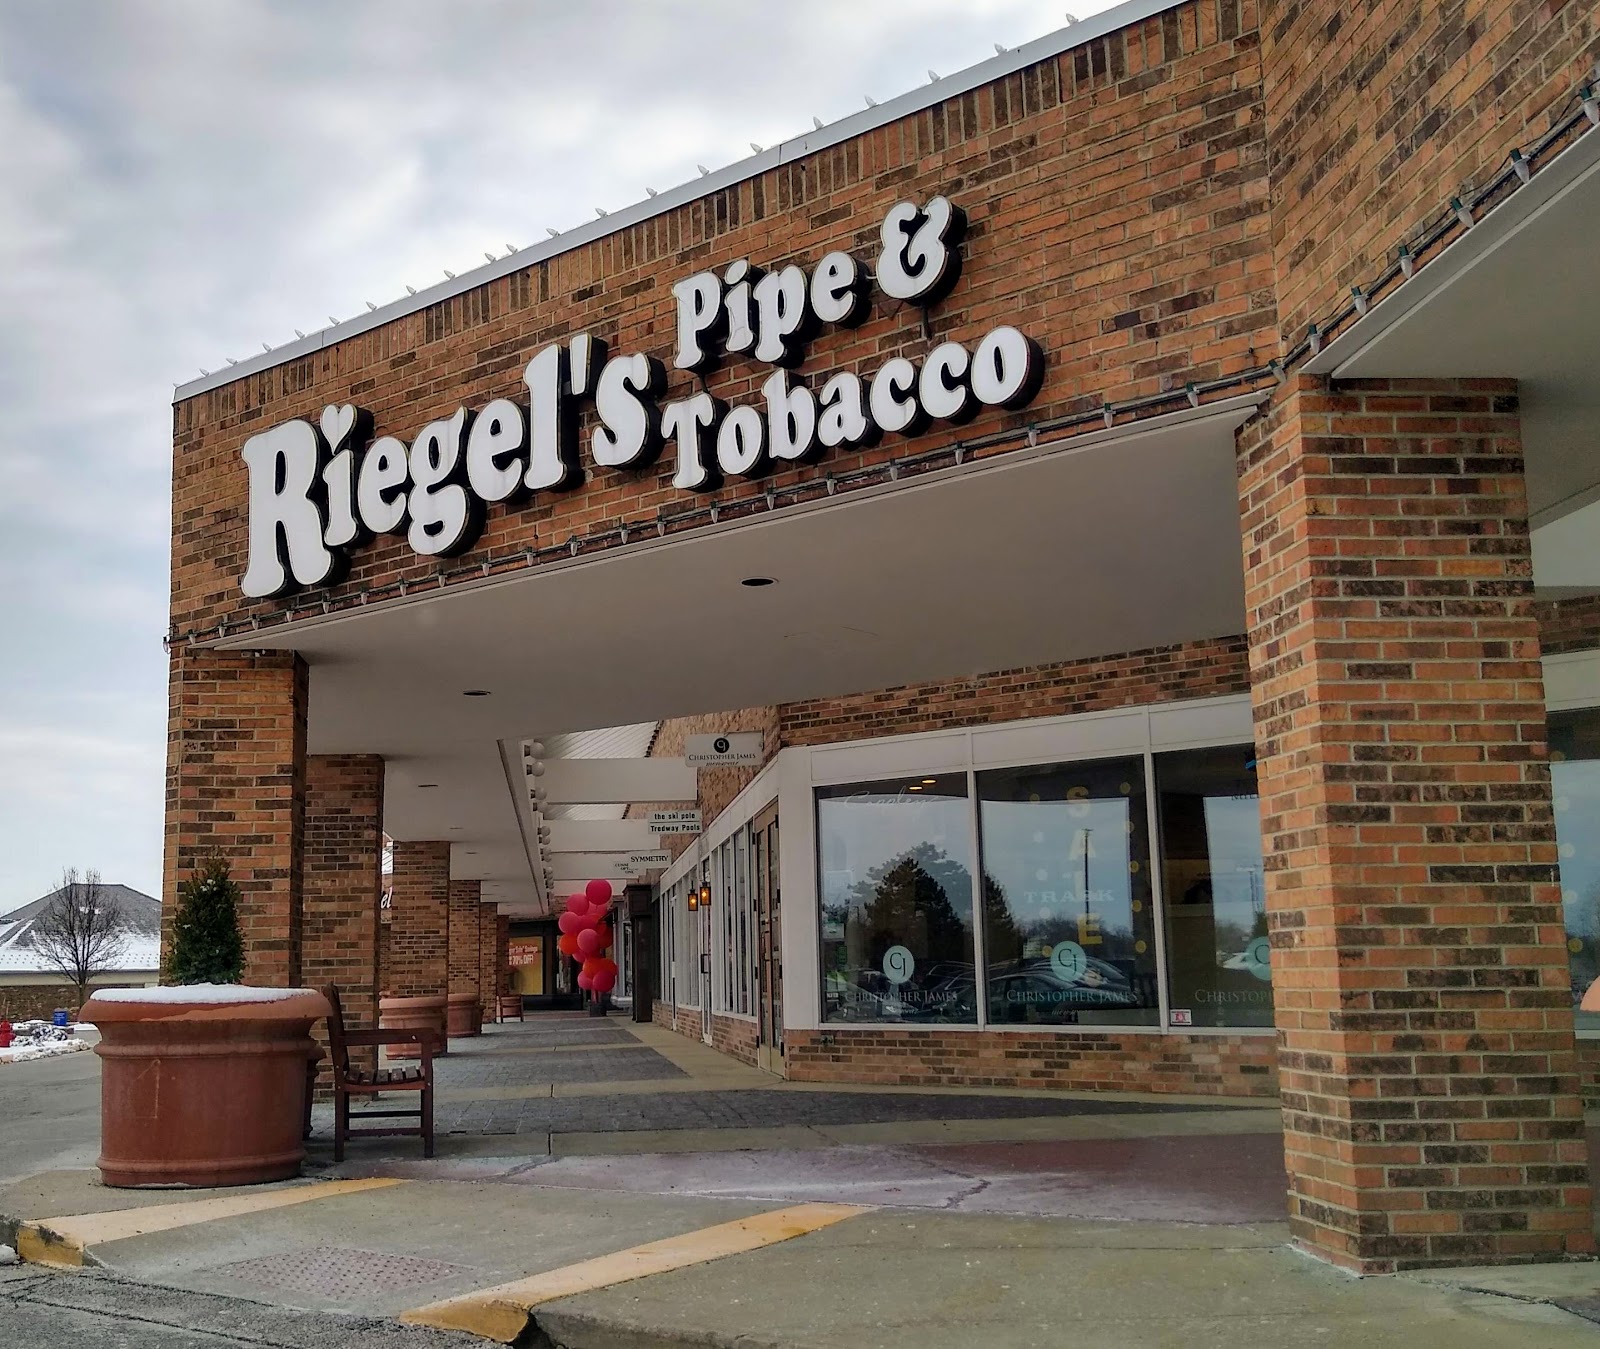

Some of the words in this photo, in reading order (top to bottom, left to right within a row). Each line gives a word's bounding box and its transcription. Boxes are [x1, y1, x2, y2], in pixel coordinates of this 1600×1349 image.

[672, 251, 860, 370] Pipe
[875, 195, 954, 301] &
[660, 324, 1031, 491] Tobacco
[688, 753, 735, 762] CHRISTOPHER
[736, 752, 756, 761] JAMES
[668, 812, 679, 820] ski
[681, 811, 696, 821] pole
[651, 824, 679, 833] Tredway
[682, 824, 700, 832] Pools
[630, 855, 669, 863] SYMMETRY
[923, 989, 958, 1004] JAMES
[1006, 989, 1096, 1003] CHRISTOPHER
[1098, 990, 1138, 1005] JAMES
[1194, 988, 1272, 1003] CHRISTOP
